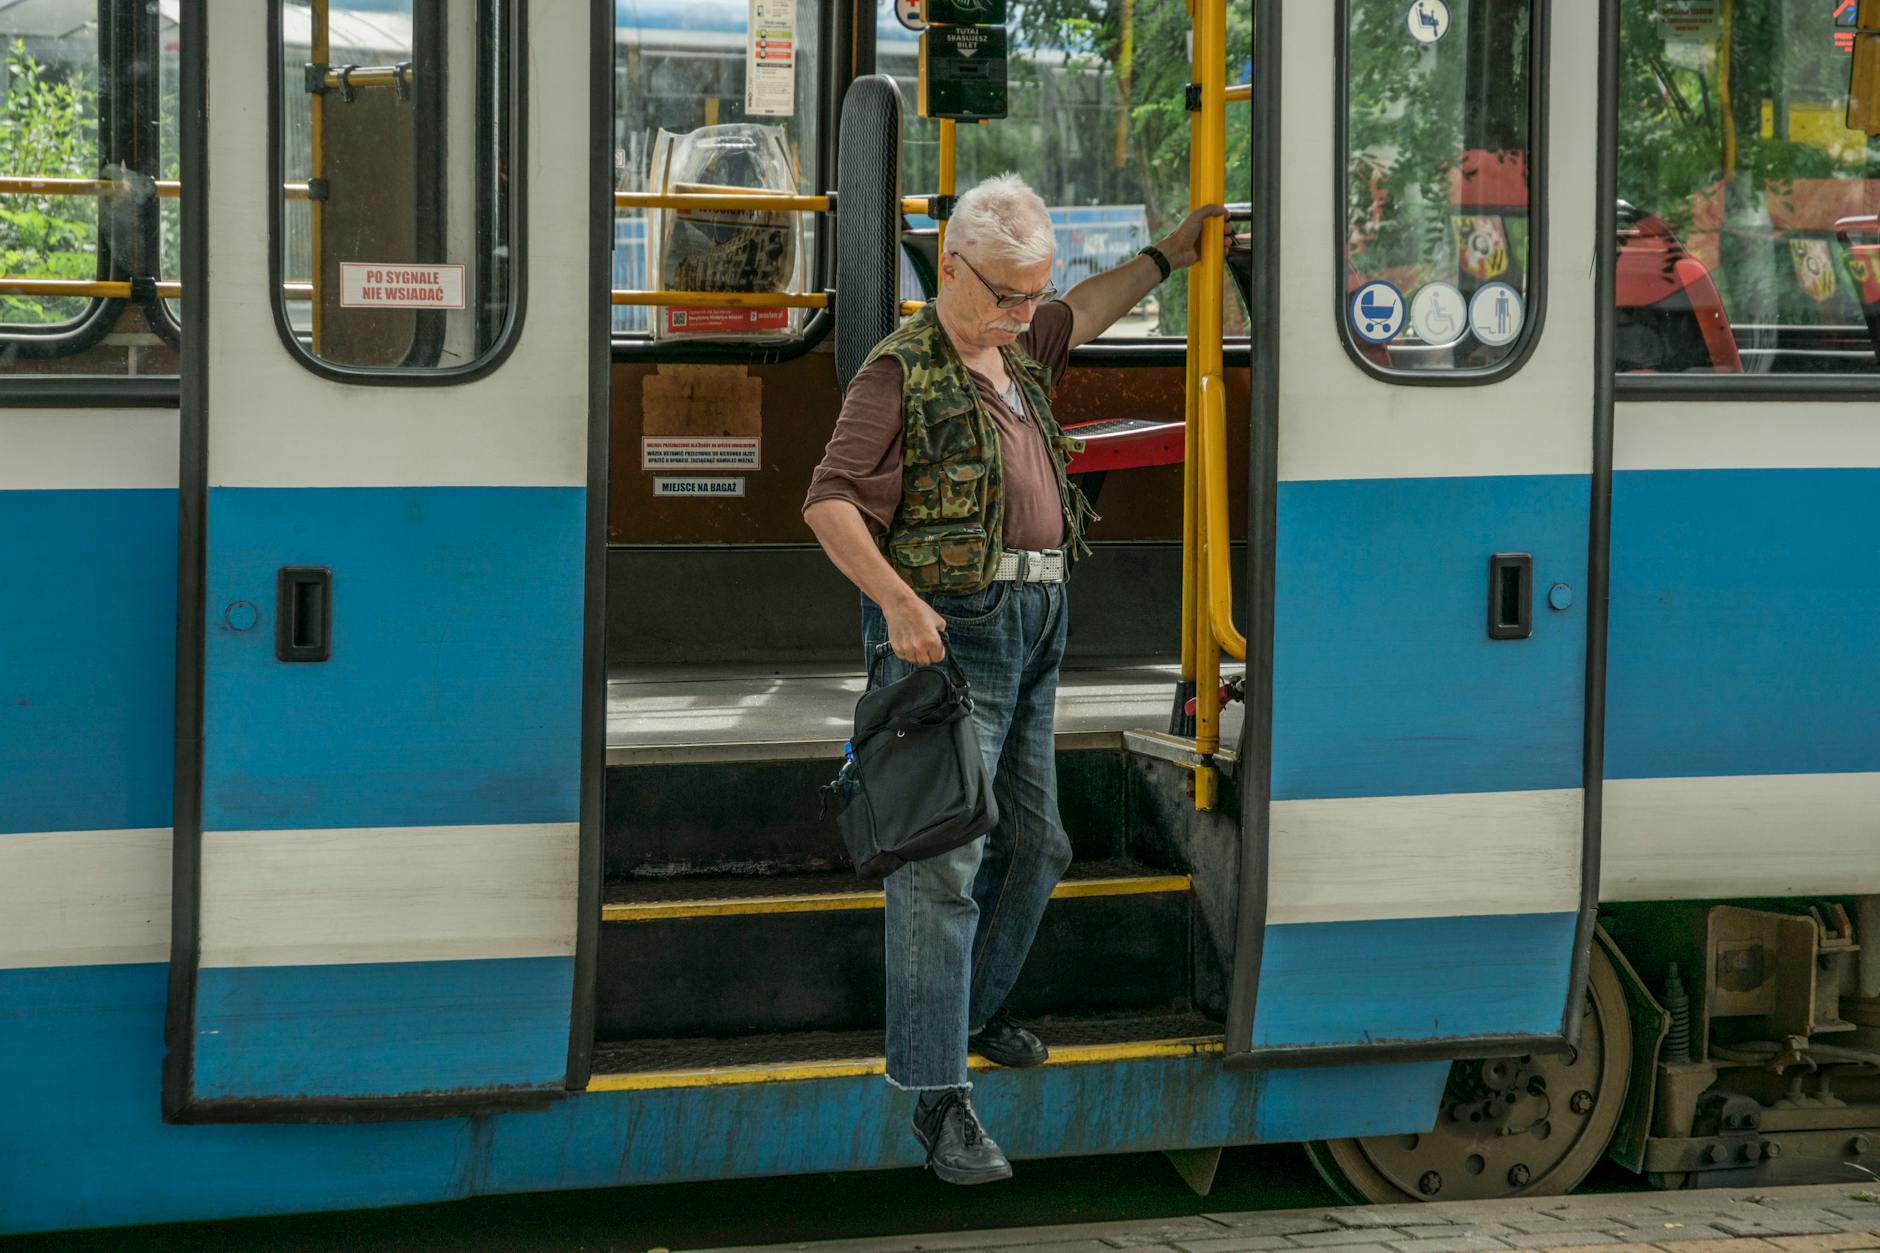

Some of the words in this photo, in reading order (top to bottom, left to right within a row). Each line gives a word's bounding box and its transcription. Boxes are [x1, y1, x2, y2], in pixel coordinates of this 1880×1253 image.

[955, 27, 979, 35] TUTAJ
[946, 34, 988, 42] SKASUJESZ
[956, 41, 978, 49] BILET
[366, 270, 383, 284] PO
[386, 270, 440, 285] SYGNALE
[362, 286, 383, 300] NIE
[384, 285, 444, 301] WSIADAĆ
[662, 482, 696, 492] MIEJSCE
[697, 482, 709, 492] NA
[710, 482, 737, 492] BAGAŻ
